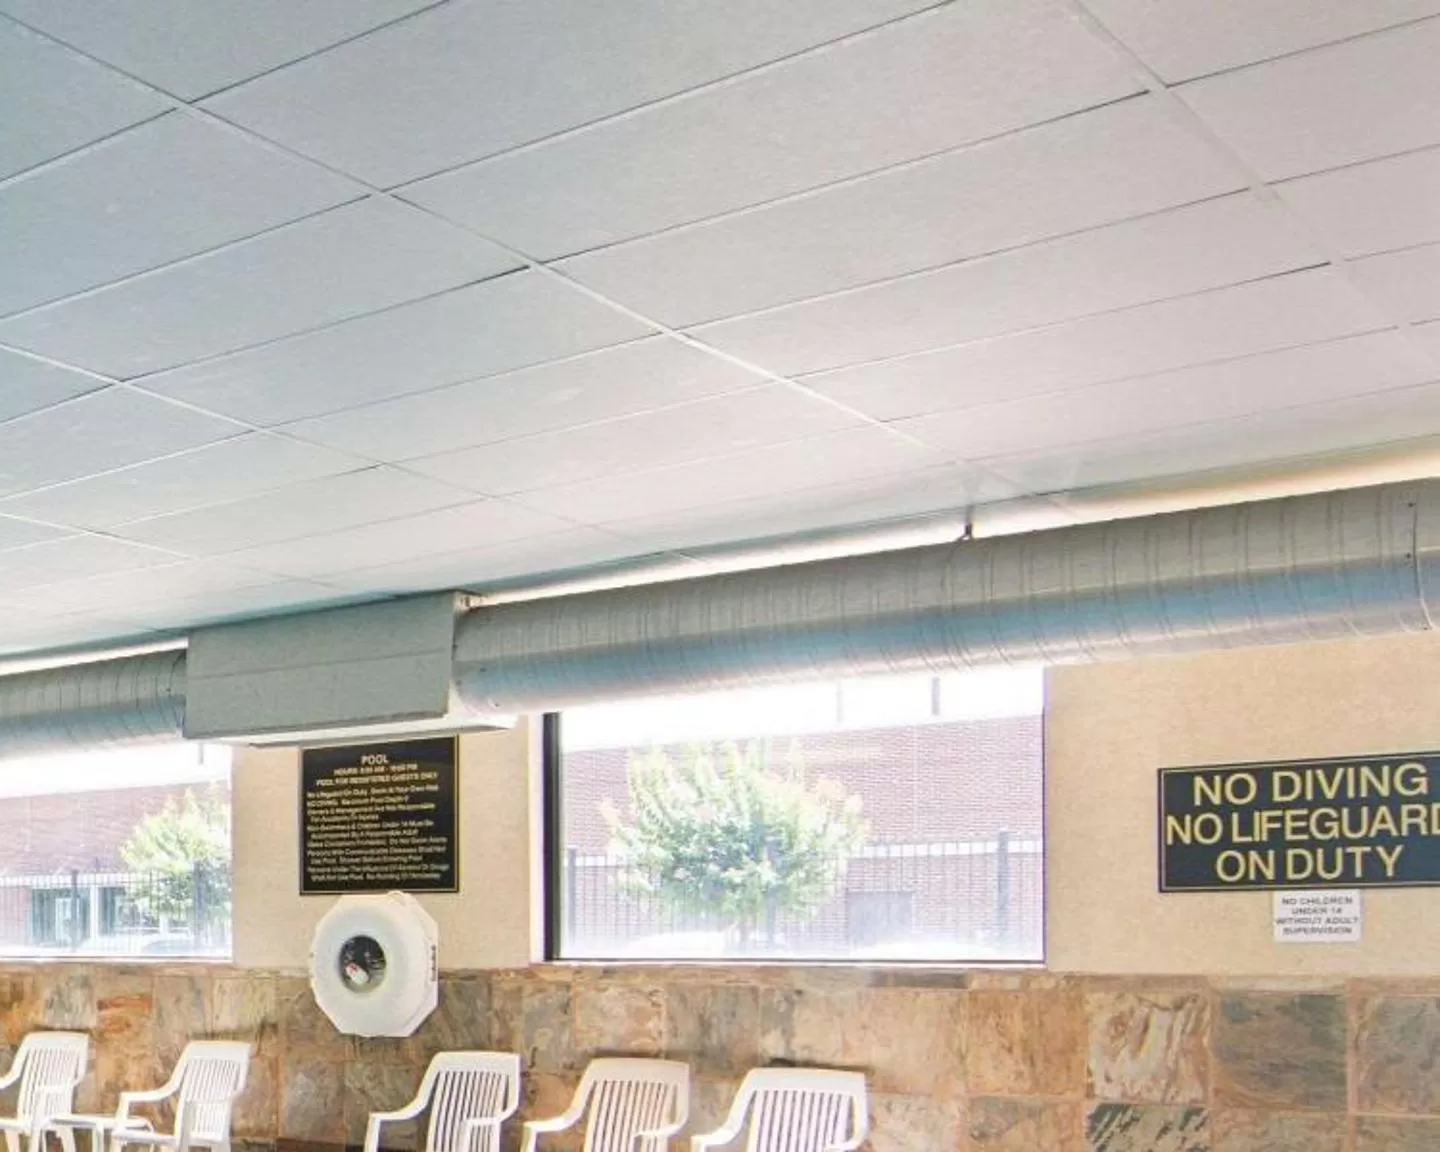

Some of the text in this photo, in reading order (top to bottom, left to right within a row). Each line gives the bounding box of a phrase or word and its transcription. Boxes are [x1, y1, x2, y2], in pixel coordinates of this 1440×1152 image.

[361, 754, 389, 765] POOL
[1193, 763, 1428, 806] NO DIVING
[1166, 812, 1223, 845] NO
[1216, 844, 1404, 882] ON DUTY
